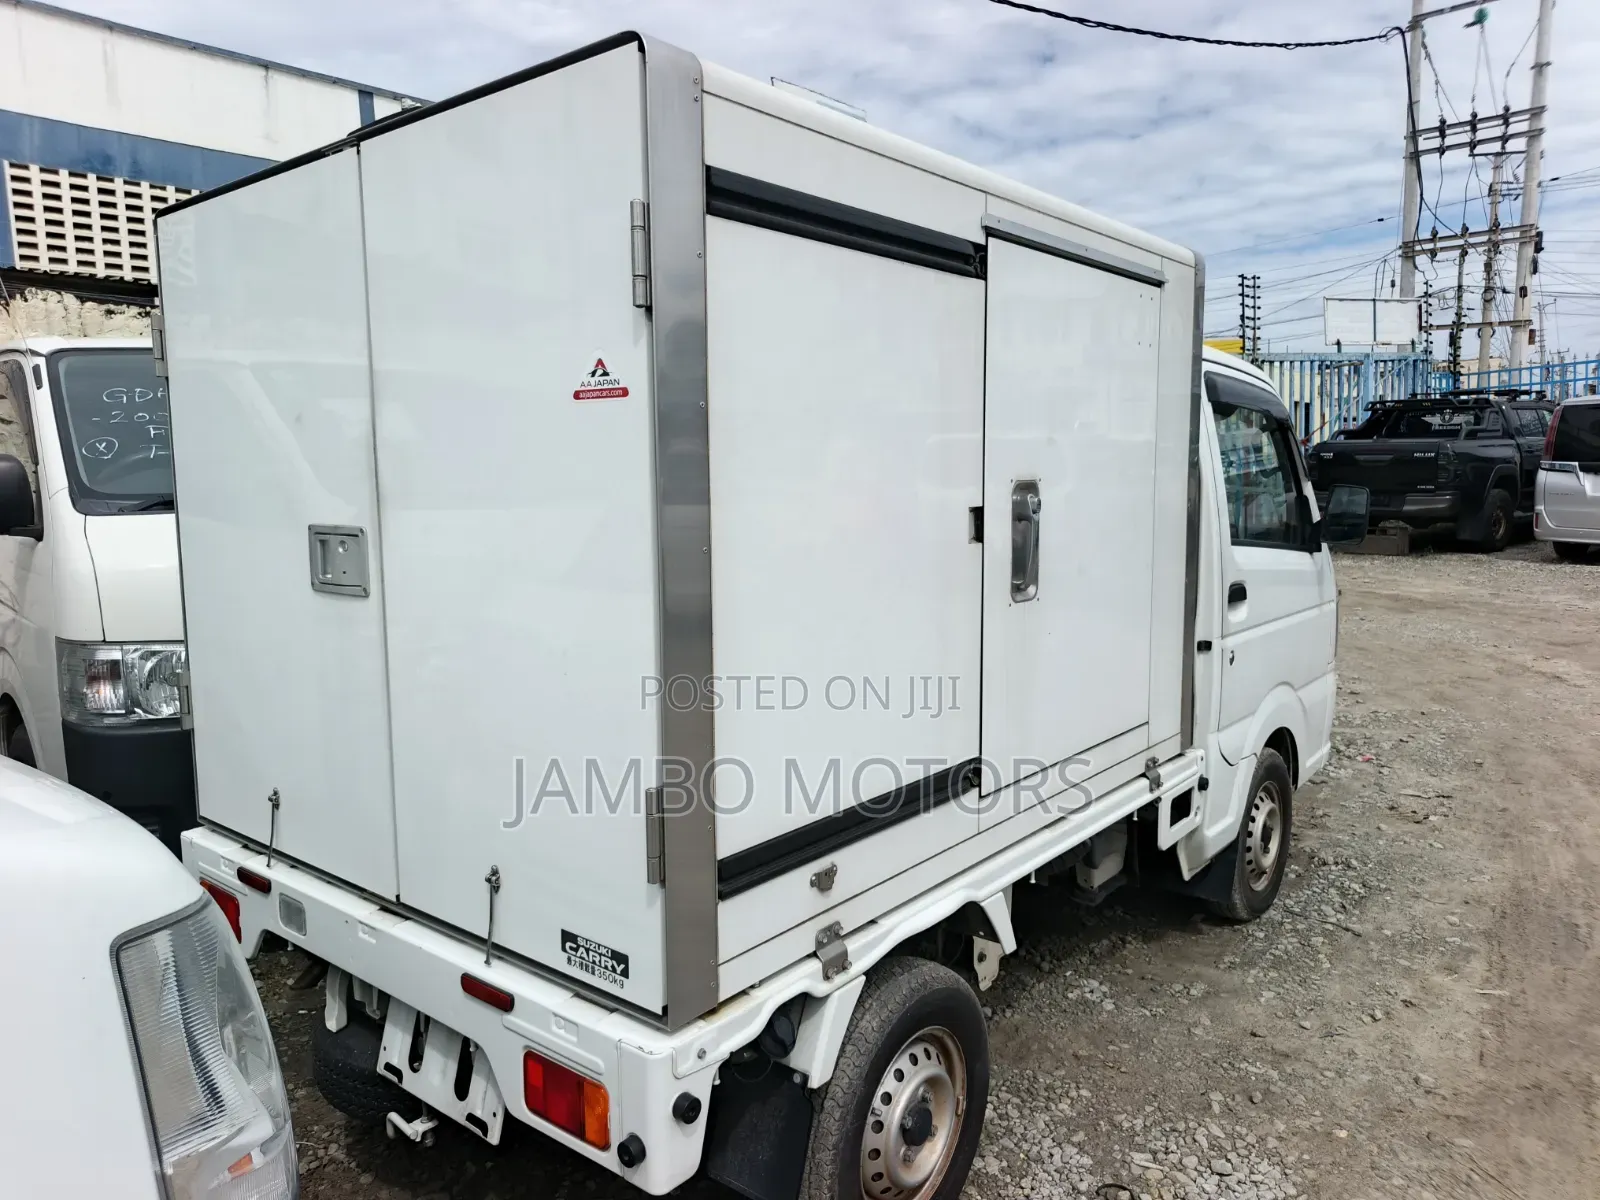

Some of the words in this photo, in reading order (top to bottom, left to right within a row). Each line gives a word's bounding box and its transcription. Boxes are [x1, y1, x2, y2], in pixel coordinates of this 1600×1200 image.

[593, 378, 620, 388] JAPAN
[579, 389, 623, 399] aajapancars.com
[577, 936, 612, 958] SUZUKI
[565, 941, 626, 975] CARRY
